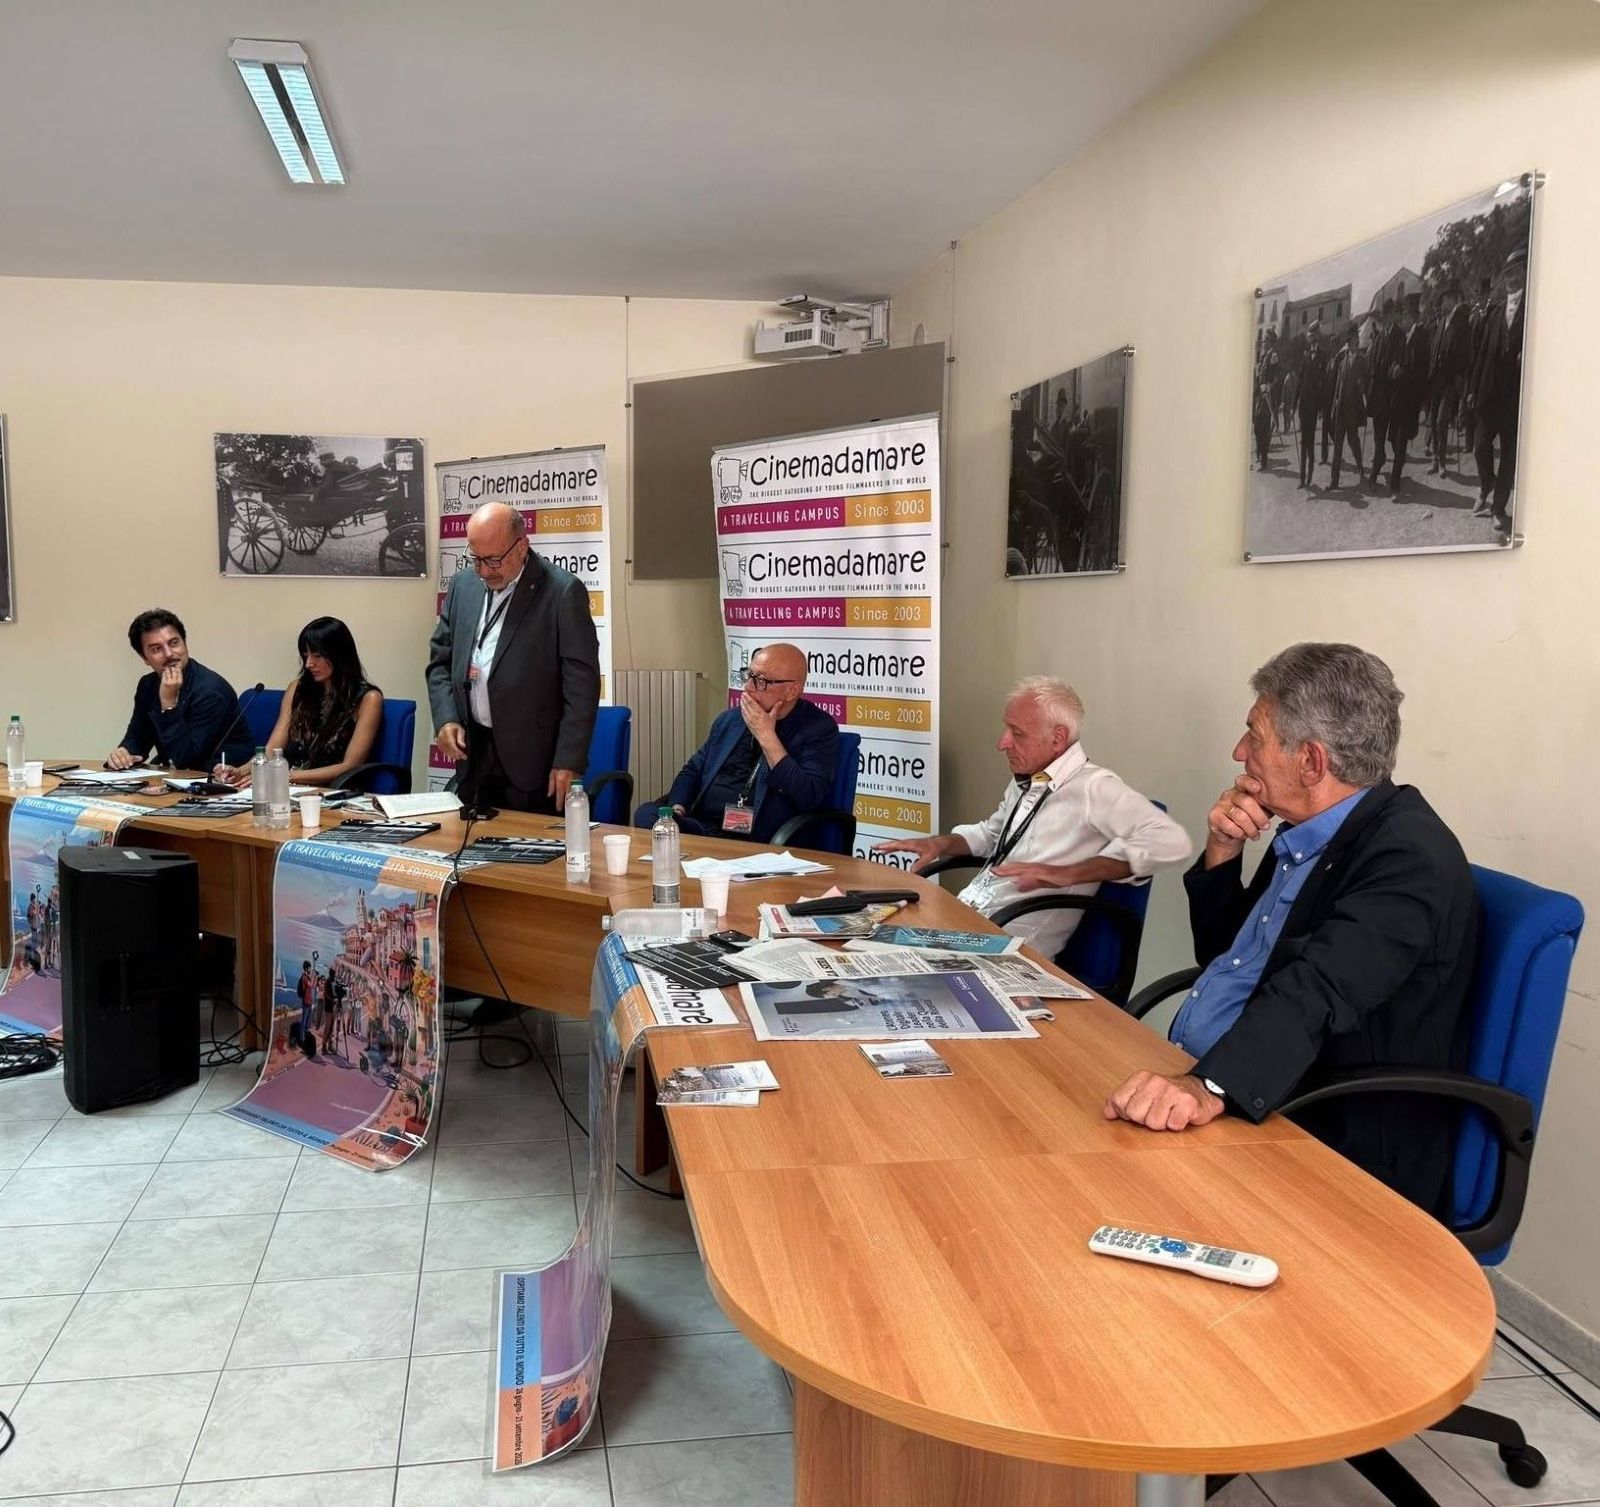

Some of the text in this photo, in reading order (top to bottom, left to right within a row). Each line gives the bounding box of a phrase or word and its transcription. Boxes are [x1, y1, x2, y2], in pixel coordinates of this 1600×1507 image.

[750, 442, 926, 486] Cinemadamare
[468, 468, 598, 499] Cinemadamare
[760, 489, 783, 498] BIGGEST
[784, 487, 813, 496] GATHERING
[825, 483, 844, 491] YOUNG
[846, 480, 884, 490] FILMMAKERS
[906, 476, 927, 485] WORLD
[723, 506, 840, 527] A TRAVELLING CAMPUS
[854, 498, 925, 519] Since 2003
[443, 524, 448, 532] A
[543, 515, 571, 527] Since
[575, 513, 597, 526] 2003
[748, 549, 926, 582] Cinemadamare
[759, 585, 783, 593] BIGGEST
[784, 585, 817, 593] GATHERING
[818, 584, 826, 592] OF
[847, 583, 884, 591] FILMMAKERS
[905, 583, 926, 591] WORLD
[735, 607, 792, 620] TRAVELLING
[797, 606, 841, 619] CAMPUS
[853, 606, 921, 621] Since 2003
[807, 649, 925, 678] madamare
[847, 683, 884, 692] FILMMAKERS
[856, 705, 923, 724] Since 2003
[907, 787, 926, 797] WORLD
[856, 801, 923, 825] Since 2003
[285, 843, 292, 851] A
[293, 844, 344, 861] TRAVELLING
[343, 854, 382, 869] CAMPUS
[516, 1305, 525, 1327] TALENTI
[516, 1326, 525, 1336] DA
[516, 1336, 525, 1355] TUTTO
[515, 1360, 524, 1386] MONDO
[514, 1395, 522, 1412] giugno
